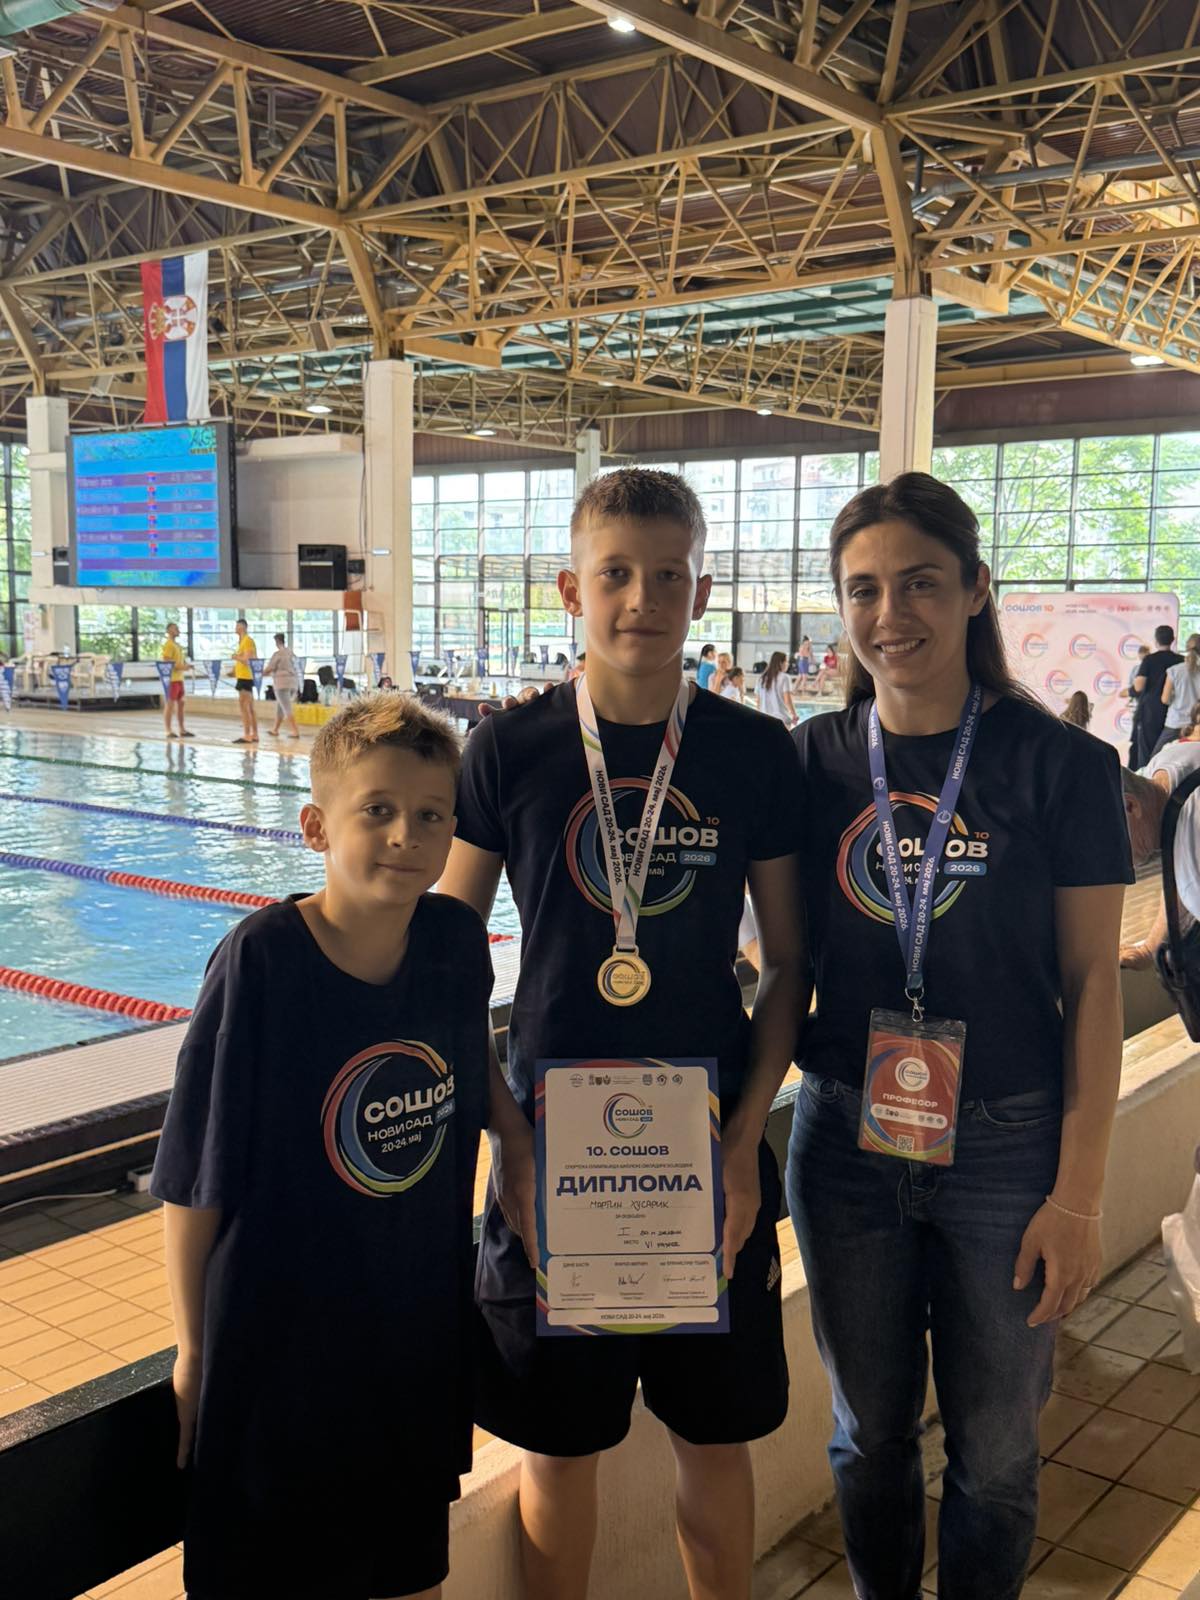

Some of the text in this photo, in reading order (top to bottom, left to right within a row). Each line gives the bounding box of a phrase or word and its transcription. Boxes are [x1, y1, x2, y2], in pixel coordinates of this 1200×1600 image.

[951, 755, 964, 780] НОВИ
[958, 737, 971, 755] САД
[595, 769, 608, 795] НОВИ
[656, 764, 668, 787] 2026.
[600, 795, 611, 816] САД
[644, 803, 657, 828] 20-24.
[605, 815, 617, 843] 20-24.
[705, 816, 720, 825] 10
[638, 830, 651, 850] САД
[973, 831, 990, 840] 10
[683, 853, 711, 863] 2026
[876, 837, 988, 858] ООВ
[612, 860, 623, 886] 2026.
[632, 850, 645, 877] НОВИ
[924, 855, 936, 880] 2026.
[950, 864, 981, 873] 2026
[882, 820, 908, 931] НОВИ САД 20-24. мај 2026.
[922, 878, 933, 896] мај
[918, 897, 930, 923] 20-24.
[914, 923, 925, 945] САД
[911, 945, 922, 972] НОВИ
[363, 1074, 455, 1124] СОШОВ
[882, 1092, 939, 1109] ПРОФЕСОР
[367, 1123, 405, 1142] НОВИ
[405, 1114, 433, 1130] САД
[381, 1130, 422, 1153] 20-24. мај
[586, 1144, 670, 1156] 10. СОШОВ
[556, 1174, 703, 1197] ДИПЛОМА
